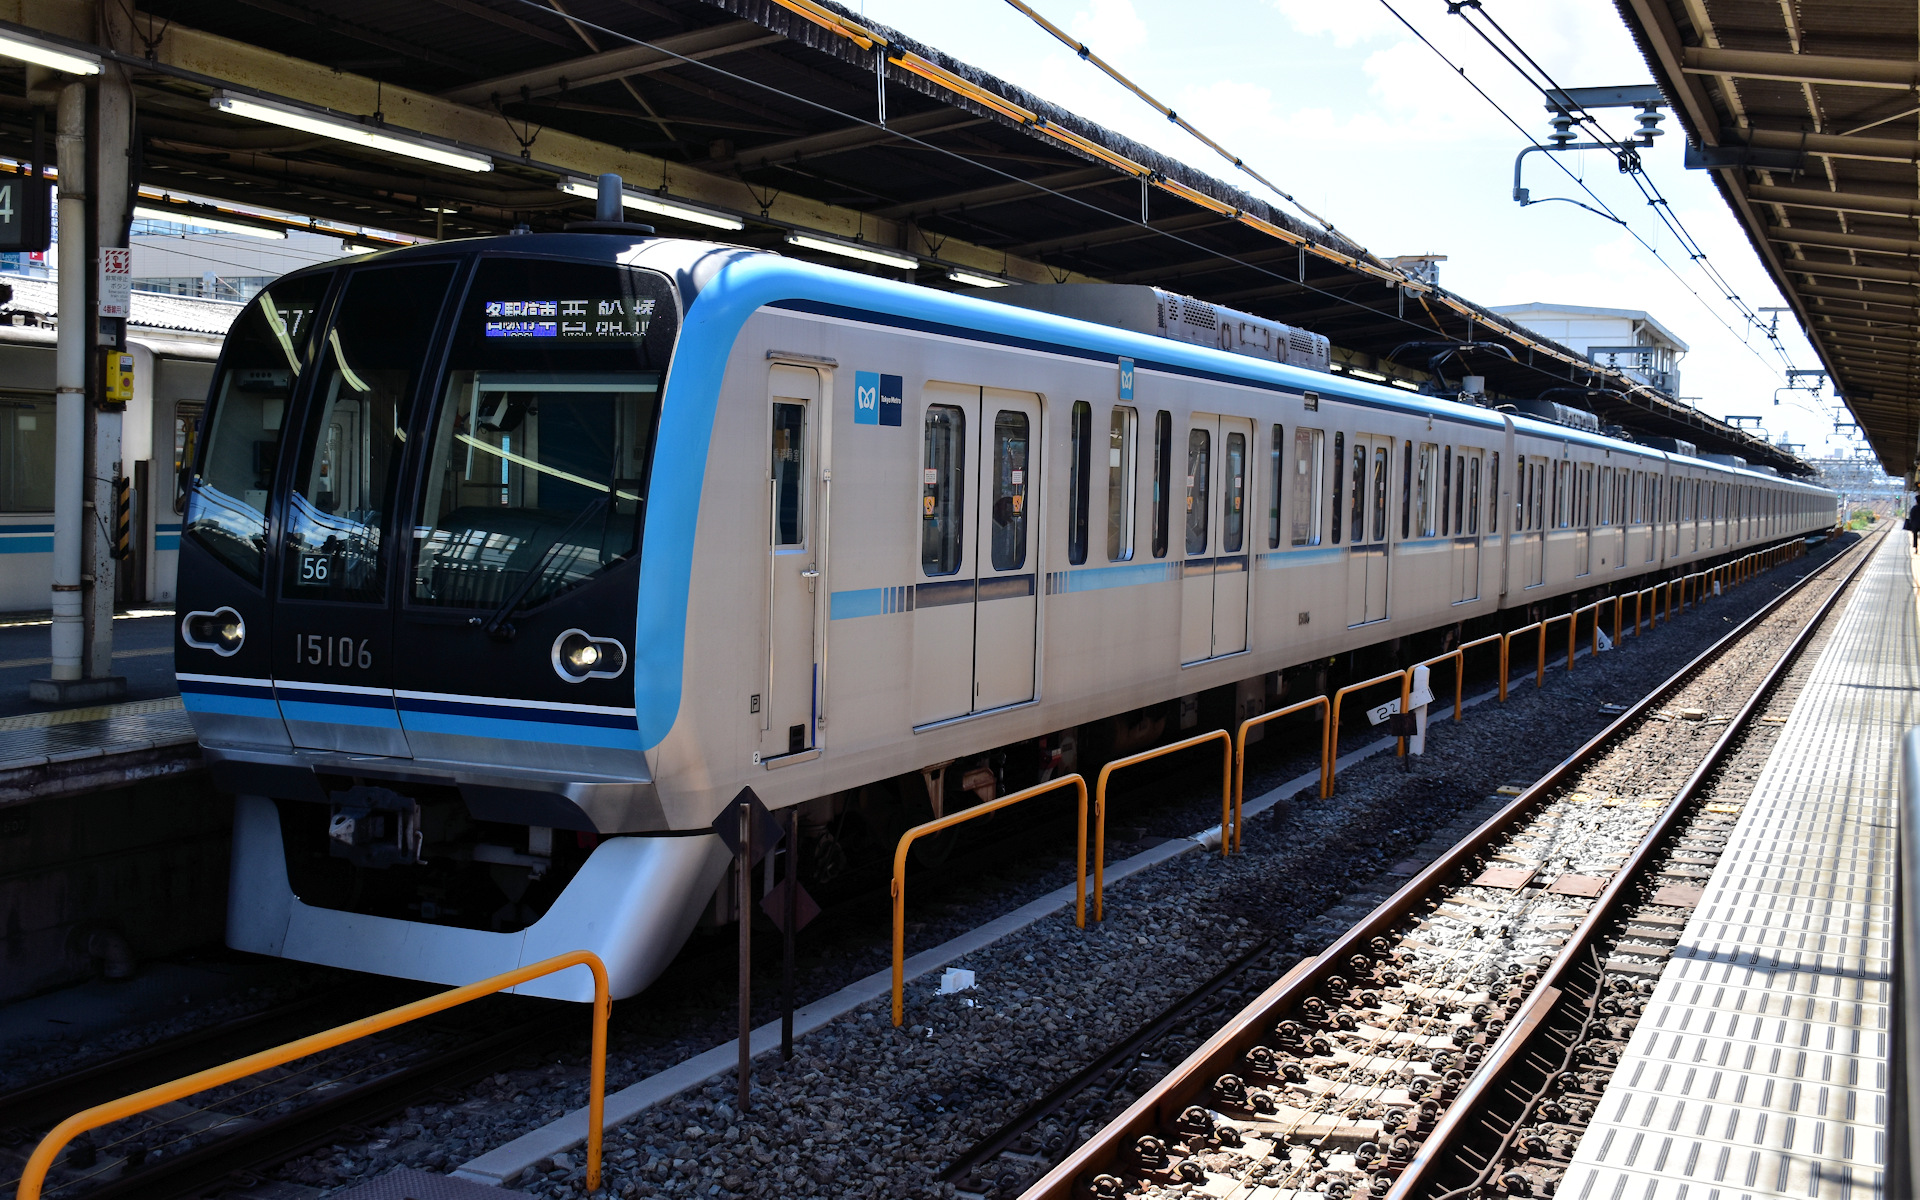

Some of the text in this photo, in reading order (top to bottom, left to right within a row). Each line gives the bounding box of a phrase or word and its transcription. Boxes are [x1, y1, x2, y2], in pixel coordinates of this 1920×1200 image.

[881, 395, 902, 404] Tokyo Metro
[303, 557, 328, 580] 56
[297, 633, 372, 669] 15106
[752, 698, 758, 710] P
[754, 753, 759, 763] 2
